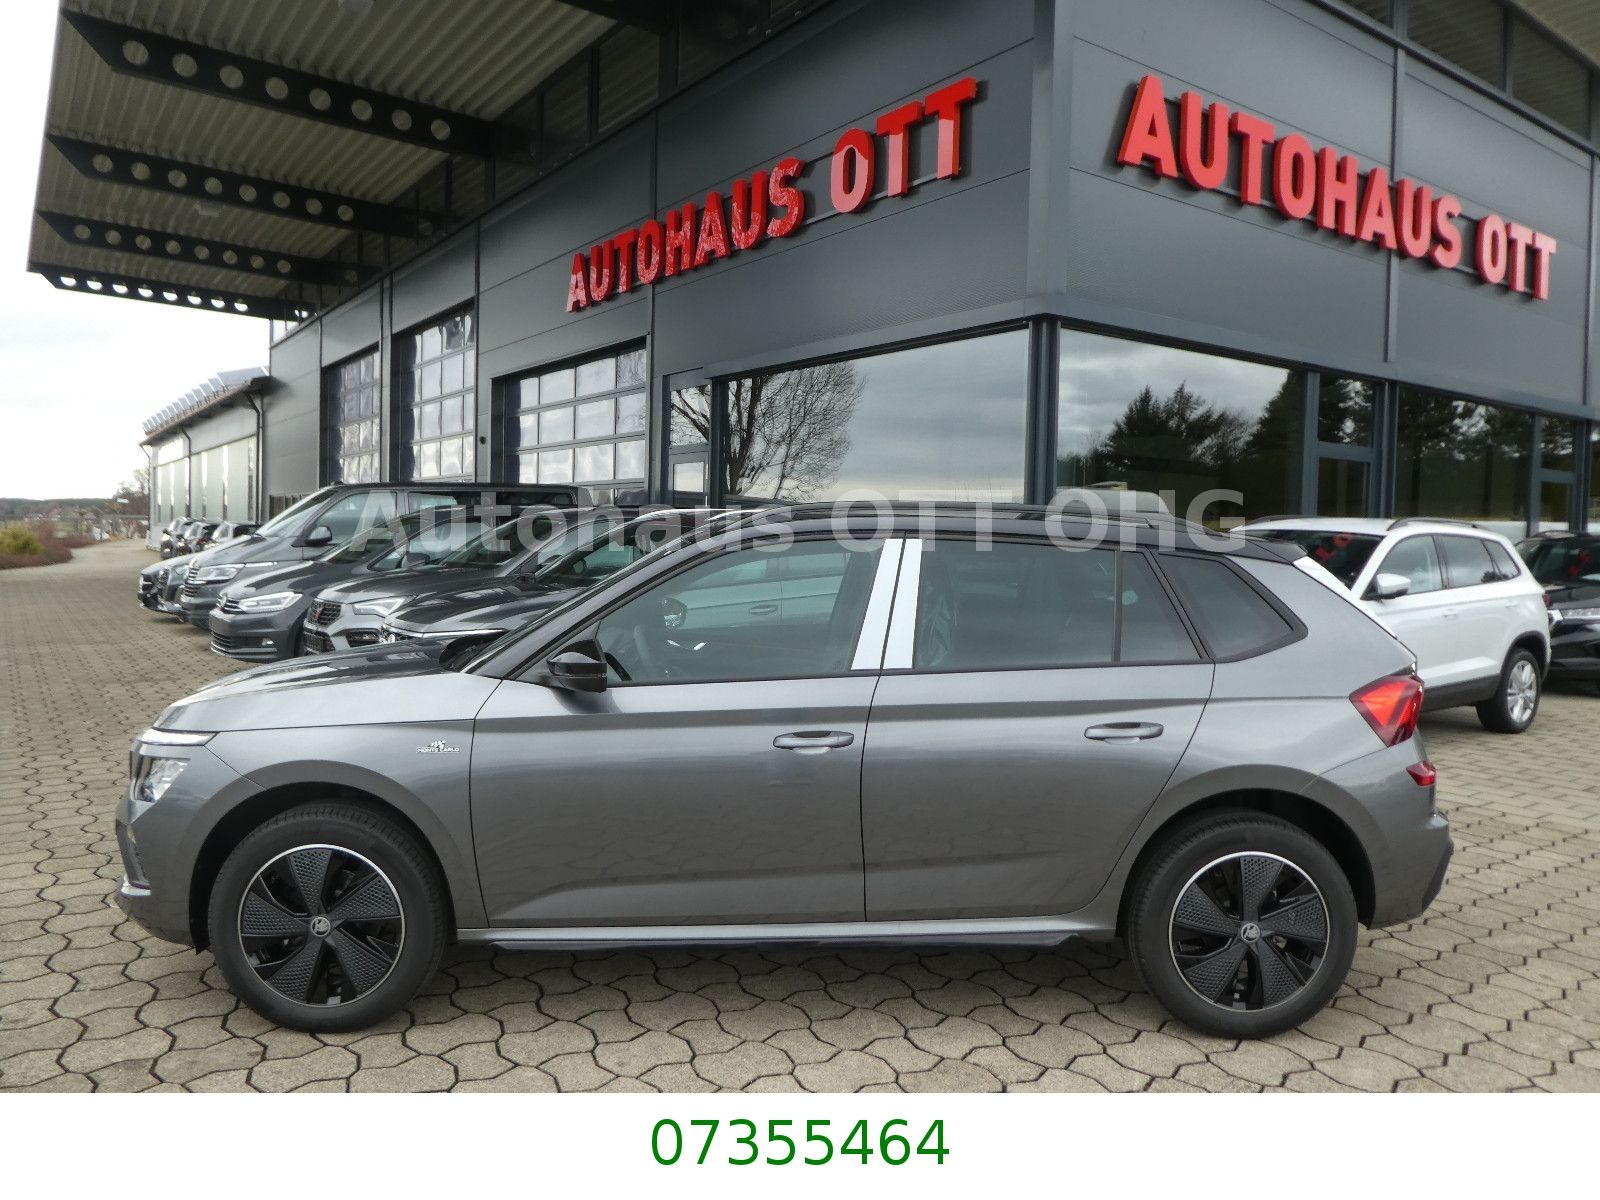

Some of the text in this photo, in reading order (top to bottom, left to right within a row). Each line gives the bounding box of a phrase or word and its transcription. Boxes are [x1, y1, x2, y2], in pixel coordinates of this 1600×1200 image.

[565, 76, 978, 312] AUTOHAUS OTT
[1117, 74, 1557, 299] AUTOHAUS OTT
